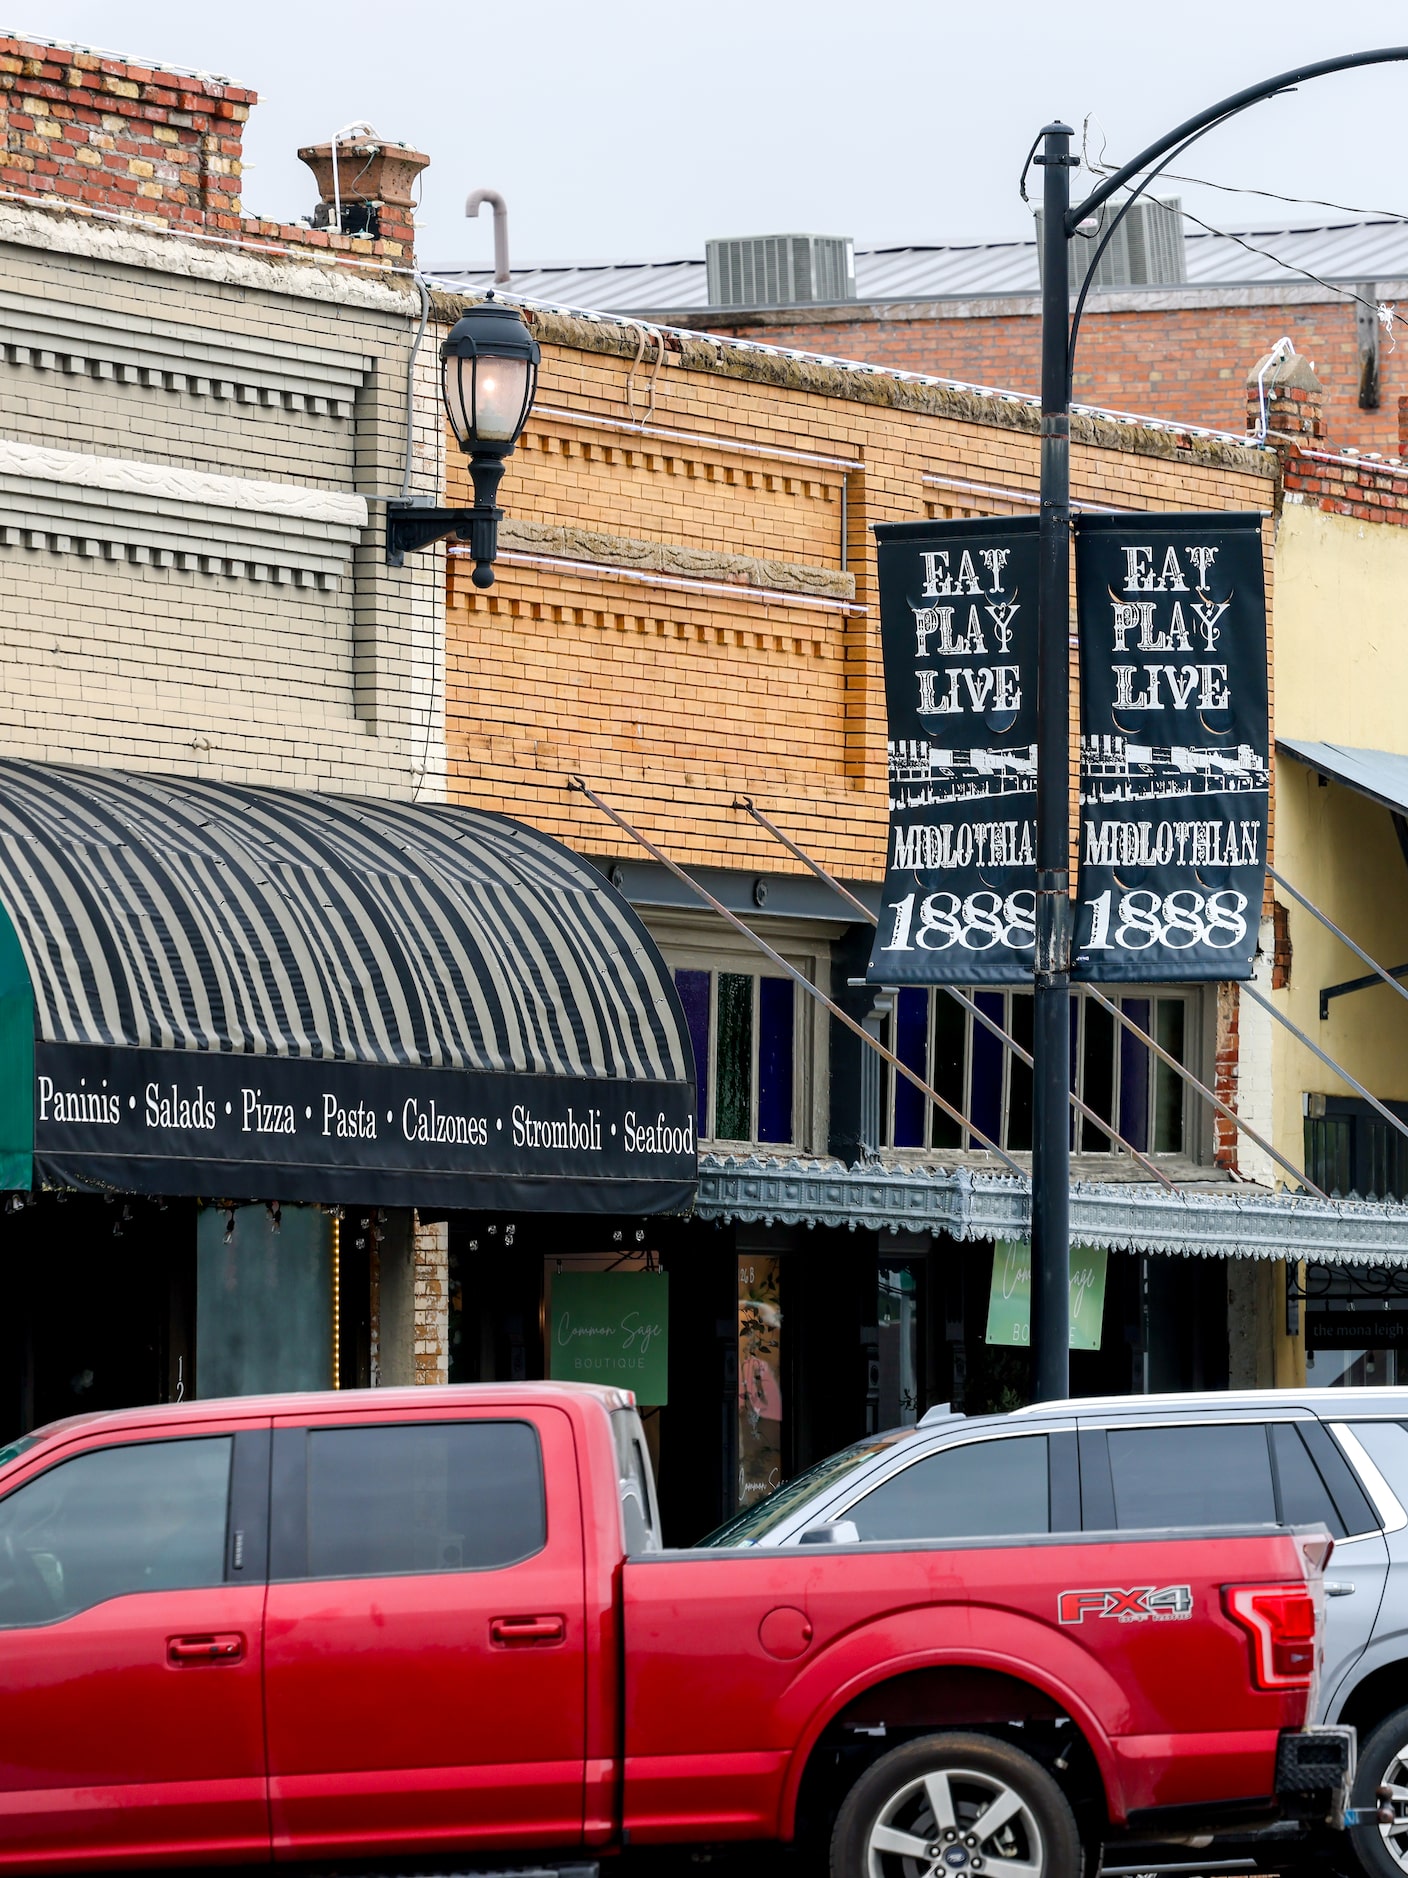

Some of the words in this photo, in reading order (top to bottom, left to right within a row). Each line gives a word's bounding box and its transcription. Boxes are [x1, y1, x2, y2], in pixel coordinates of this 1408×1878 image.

[920, 549, 1011, 597] EAT
[1121, 546, 1218, 592] EAT
[912, 602, 1021, 657] PLAY
[1111, 602, 1230, 652] PLAY
[915, 665, 1022, 714] LIVE
[1112, 665, 1231, 710] LIVE
[891, 821, 1037, 870] MIDLOTHIA
[1084, 821, 1260, 867] MIDLOTHIAN
[880, 890, 1036, 951] 1888
[1079, 889, 1248, 950] 1888
[38, 1076, 120, 1125] Paninis
[145, 1083, 216, 1131] Salads
[241, 1089, 296, 1134] Pizza
[322, 1094, 377, 1139] Pasta
[402, 1098, 487, 1146] Calzones
[512, 1105, 602, 1151] Stromboli
[624, 1111, 695, 1155] Seafood
[1068, 1266, 1095, 1318] age
[558, 1312, 617, 1346] Common
[621, 1312, 662, 1354] Sage
[1313, 1323, 1333, 1337] the
[1336, 1326, 1371, 1336] mona
[1374, 1322, 1404, 1339] leigh
[574, 1357, 645, 1368] BOUTIQUE
[1058, 1584, 1193, 1624] FX4
